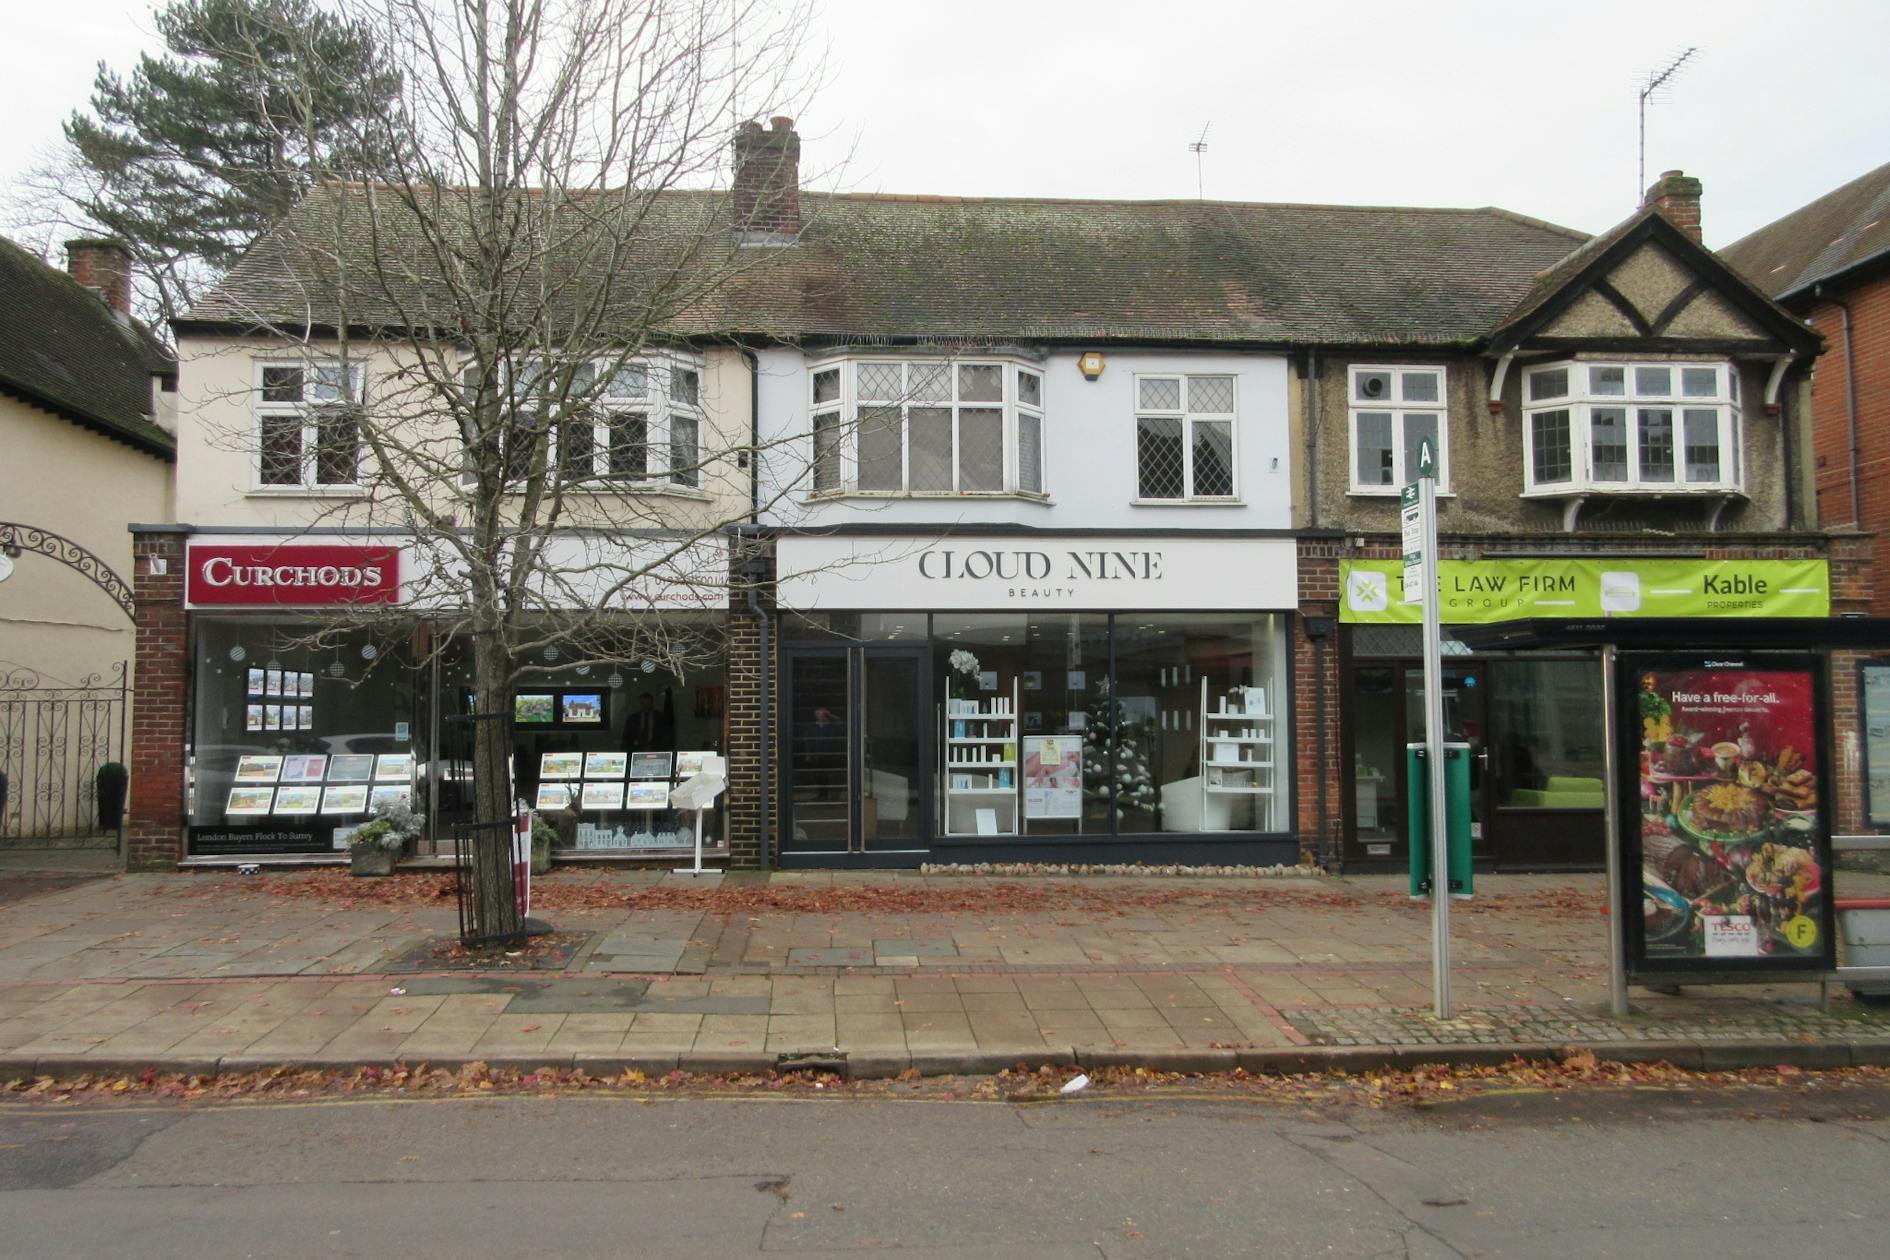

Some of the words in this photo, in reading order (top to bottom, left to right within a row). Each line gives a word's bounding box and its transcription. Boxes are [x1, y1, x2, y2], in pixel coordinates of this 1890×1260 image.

[1420, 442, 1432, 467] A
[918, 550, 1051, 579] CLOUD
[1067, 551, 1163, 579] NINE
[202, 557, 382, 587] CURCHODS
[1455, 575, 1507, 592] LAW
[1519, 575, 1576, 592] FIRM
[1703, 574, 1767, 594] Kable
[624, 591, 725, 601] www.curchodscom
[1008, 588, 1075, 597] BEAUTY
[1449, 598, 1525, 608] GROUP
[1707, 601, 1763, 609] PROPERTIES
[1672, 691, 1701, 703] Have
[1703, 694, 1711, 703] a
[1713, 691, 1780, 704] free-for-all.
[197, 832, 227, 841] London
[228, 832, 254, 842] Buyers
[255, 832, 276, 840] Flock
[278, 832, 288, 840] To
[289, 831, 313, 842] Surrey
[1711, 922, 1751, 932] TESCO
